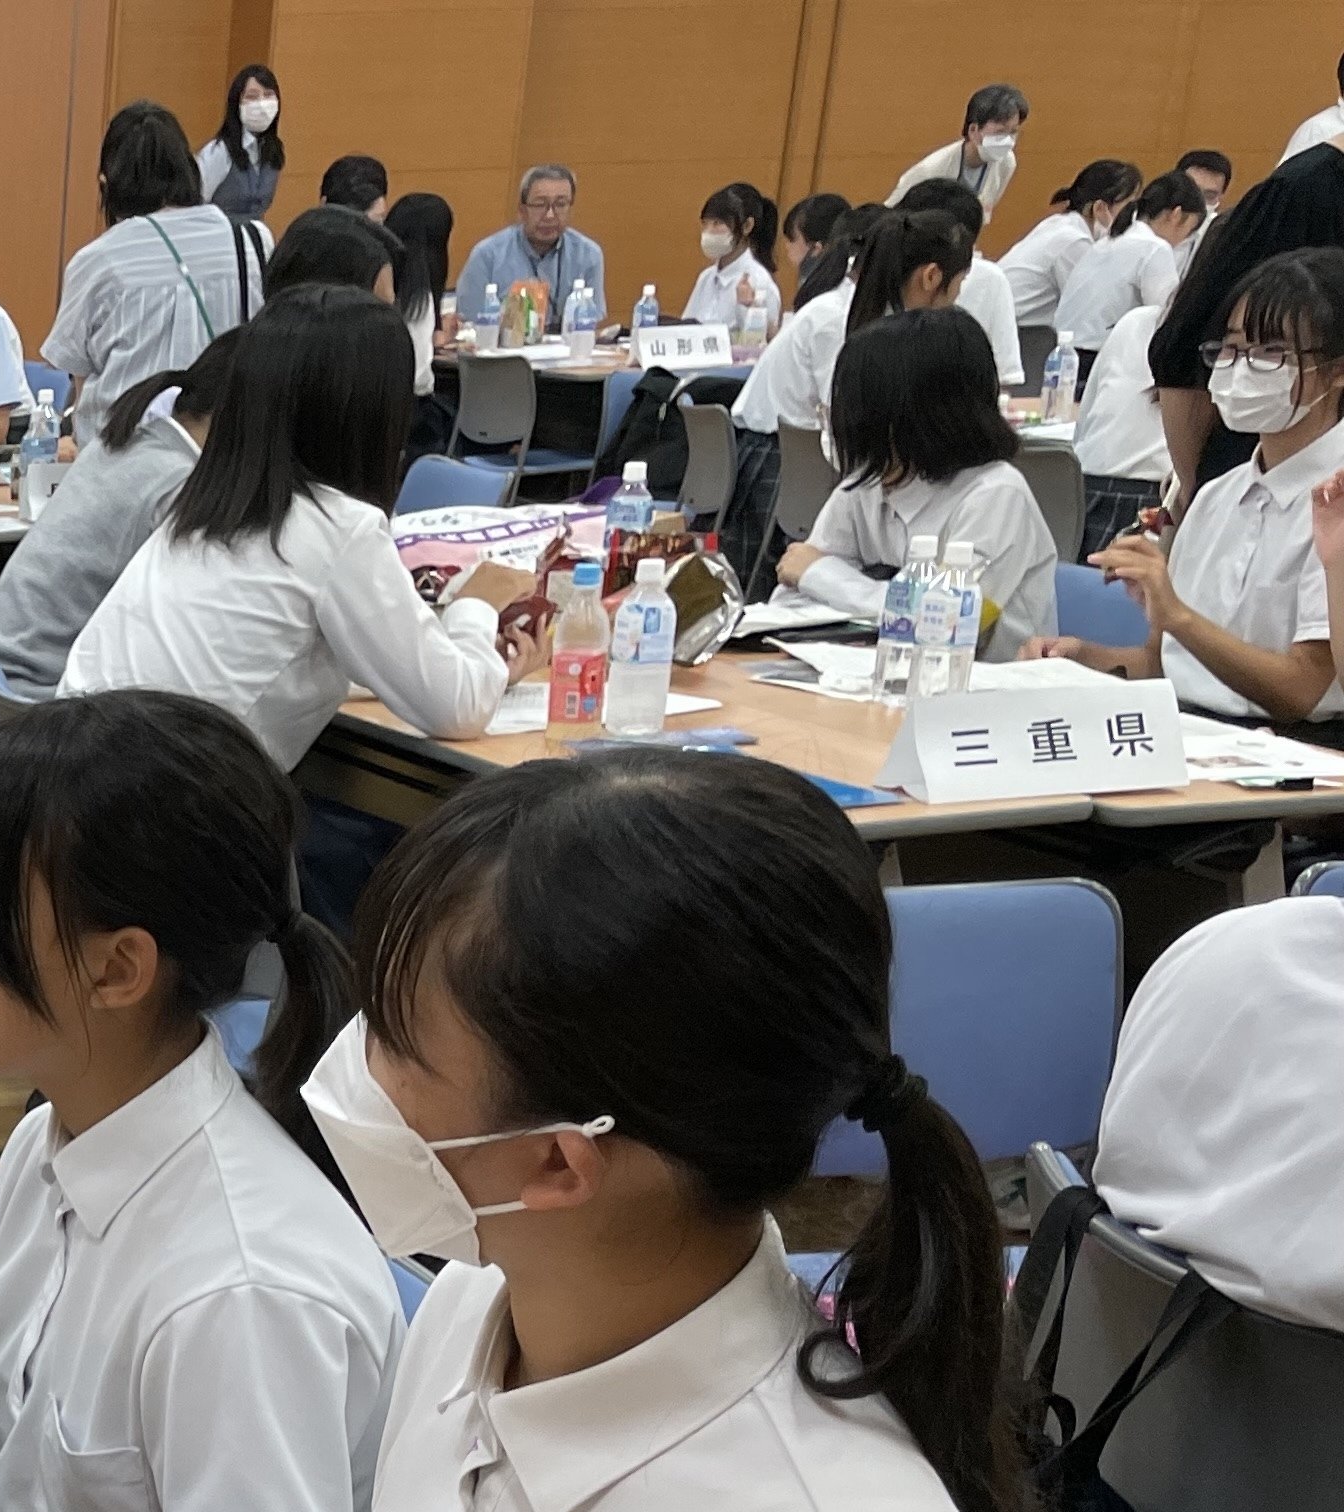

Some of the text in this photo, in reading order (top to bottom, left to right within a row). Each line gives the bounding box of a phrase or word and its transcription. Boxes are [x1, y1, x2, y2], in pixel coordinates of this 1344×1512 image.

[649, 335, 722, 358] 山形県
[950, 711, 1155, 769] 三重県
